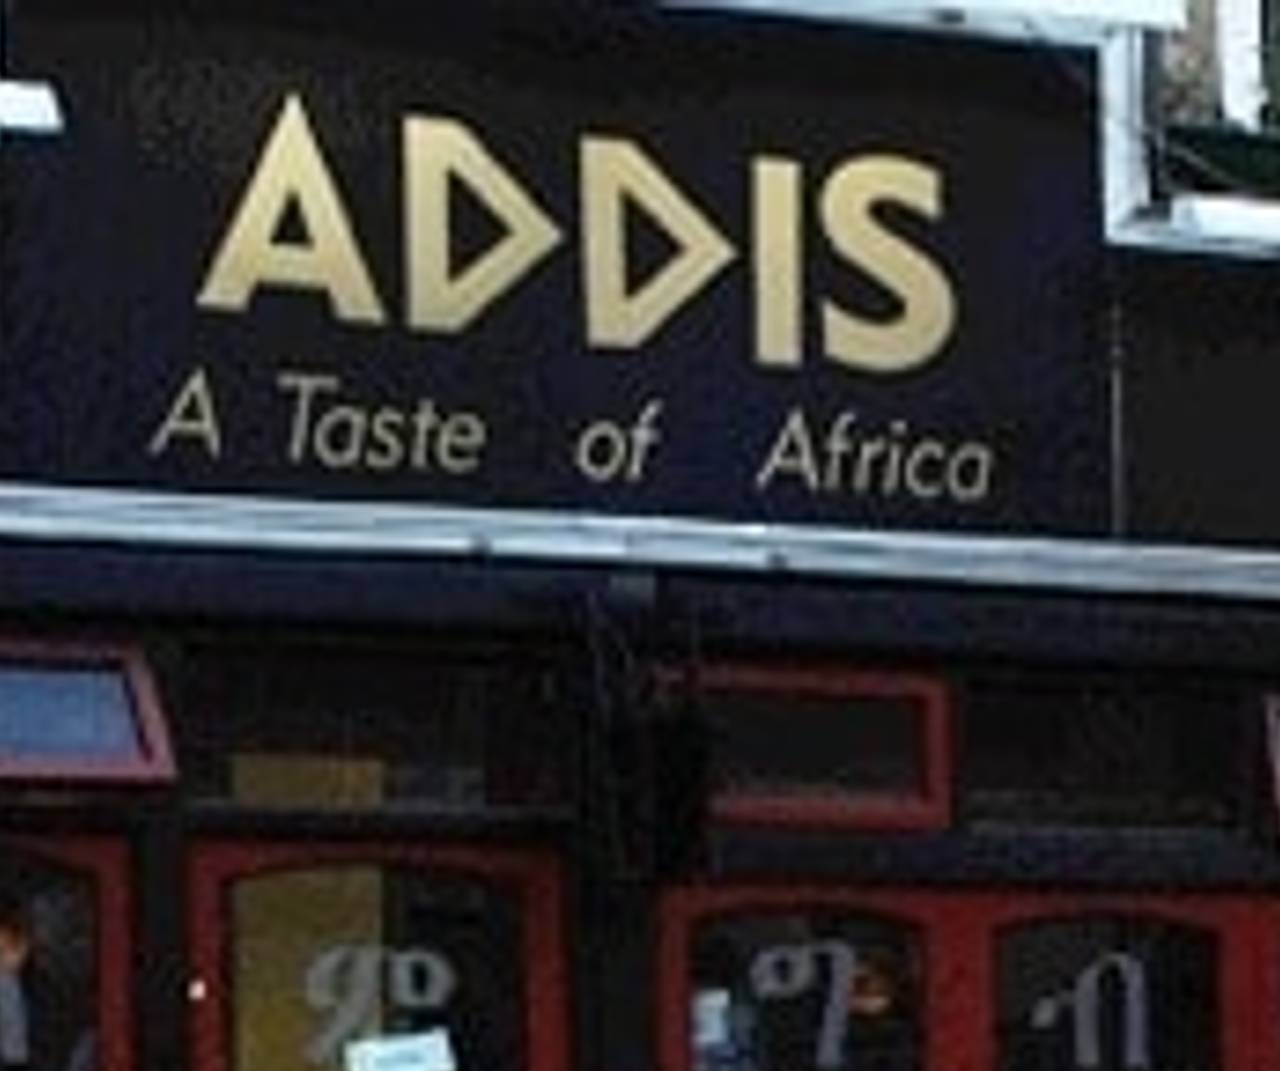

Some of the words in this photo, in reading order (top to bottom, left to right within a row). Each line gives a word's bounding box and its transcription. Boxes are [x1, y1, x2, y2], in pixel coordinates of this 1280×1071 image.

[197, 91, 957, 374] ADDIS
[148, 368, 220, 460] A
[277, 374, 487, 475] Taste
[574, 402, 662, 483] of
[757, 409, 992, 501] Africa
